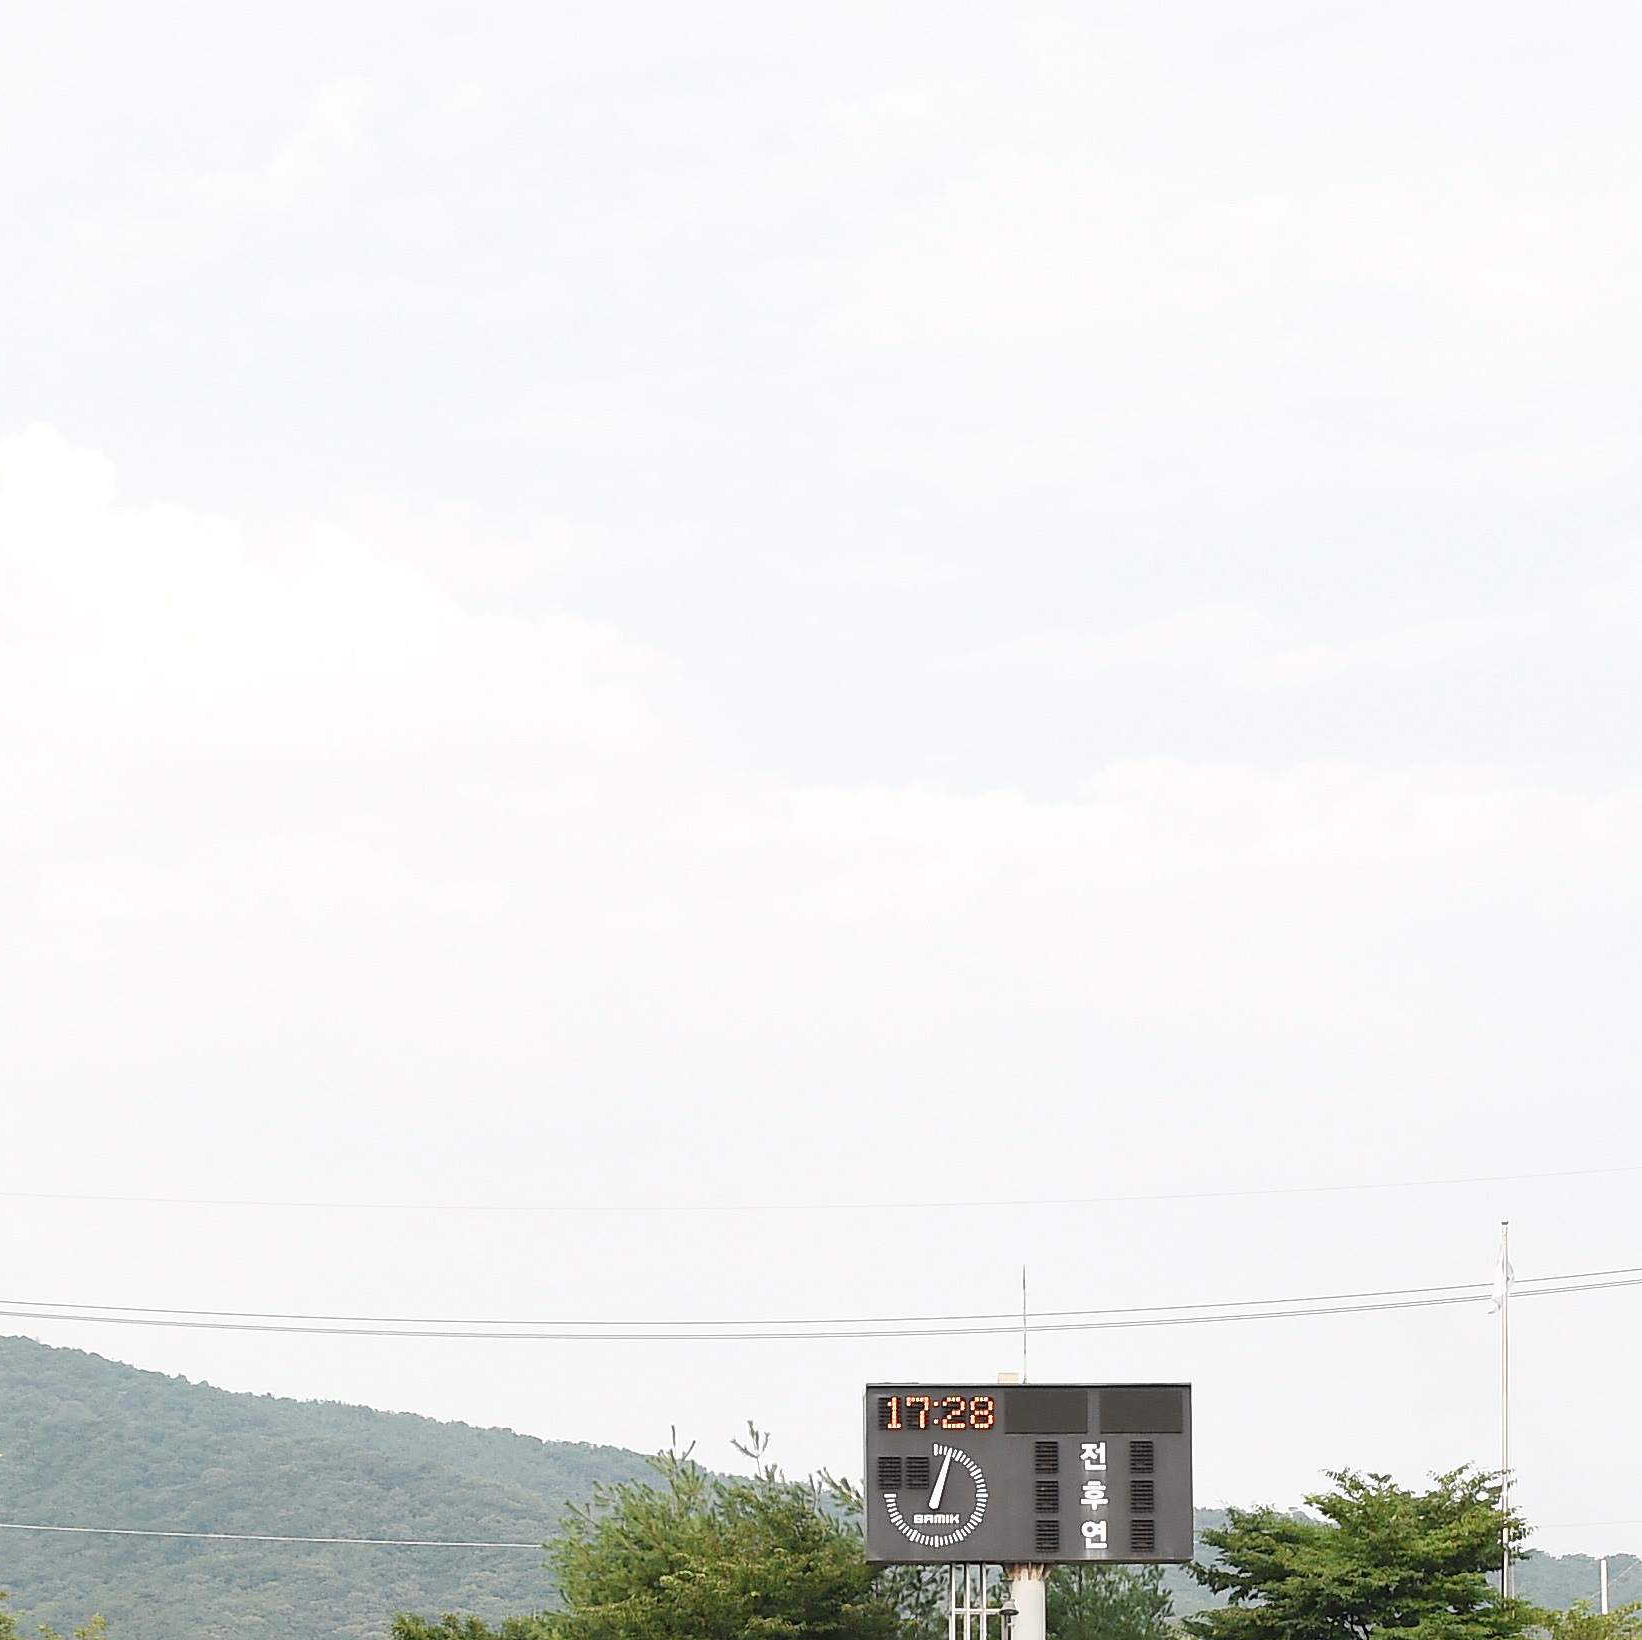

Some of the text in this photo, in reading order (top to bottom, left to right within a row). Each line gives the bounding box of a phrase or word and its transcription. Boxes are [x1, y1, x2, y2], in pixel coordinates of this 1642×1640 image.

[886, 1396, 995, 1429] 17:28
[1079, 1441, 1107, 1471] 전
[1080, 1480, 1109, 1511] 후
[1081, 1520, 1108, 1549] 연
